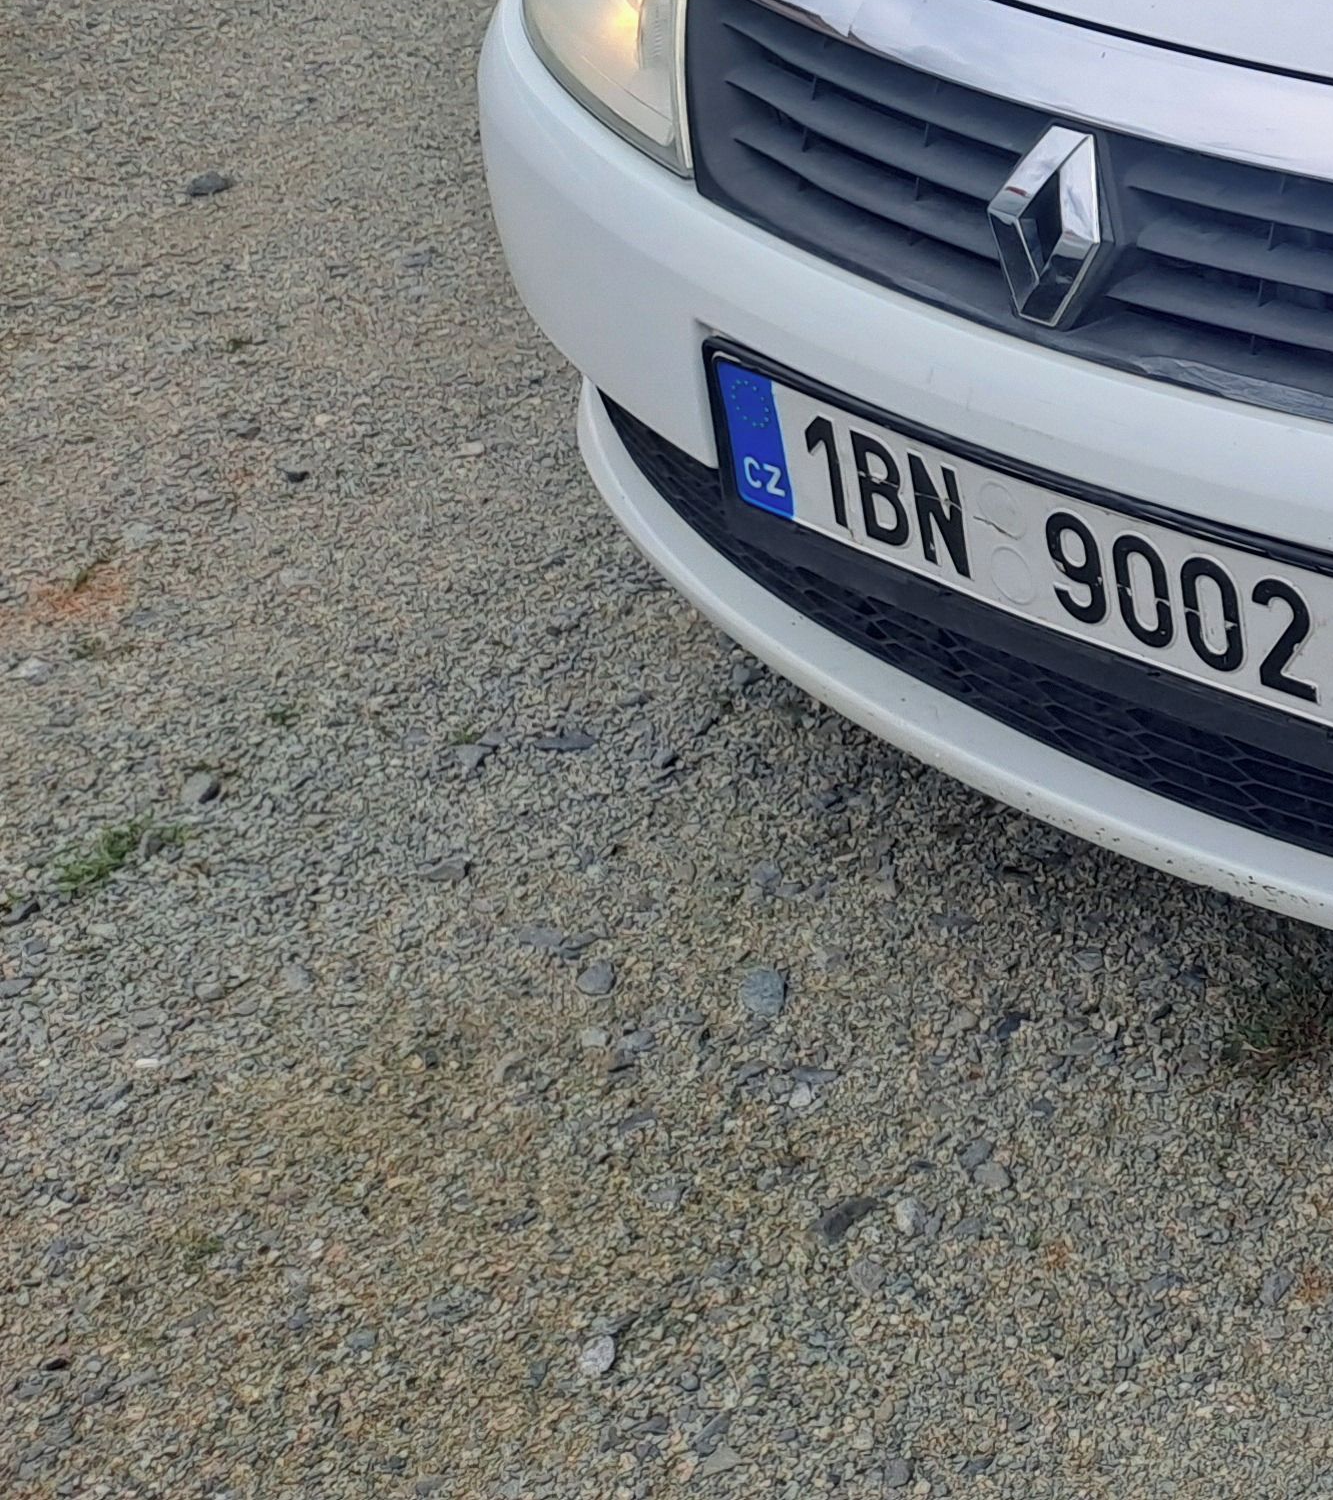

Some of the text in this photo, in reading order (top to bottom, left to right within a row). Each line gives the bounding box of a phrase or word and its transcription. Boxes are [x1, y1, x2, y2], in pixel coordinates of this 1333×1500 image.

[743, 456, 785, 497] CZ
[804, 414, 1320, 705] 1BN 9002
